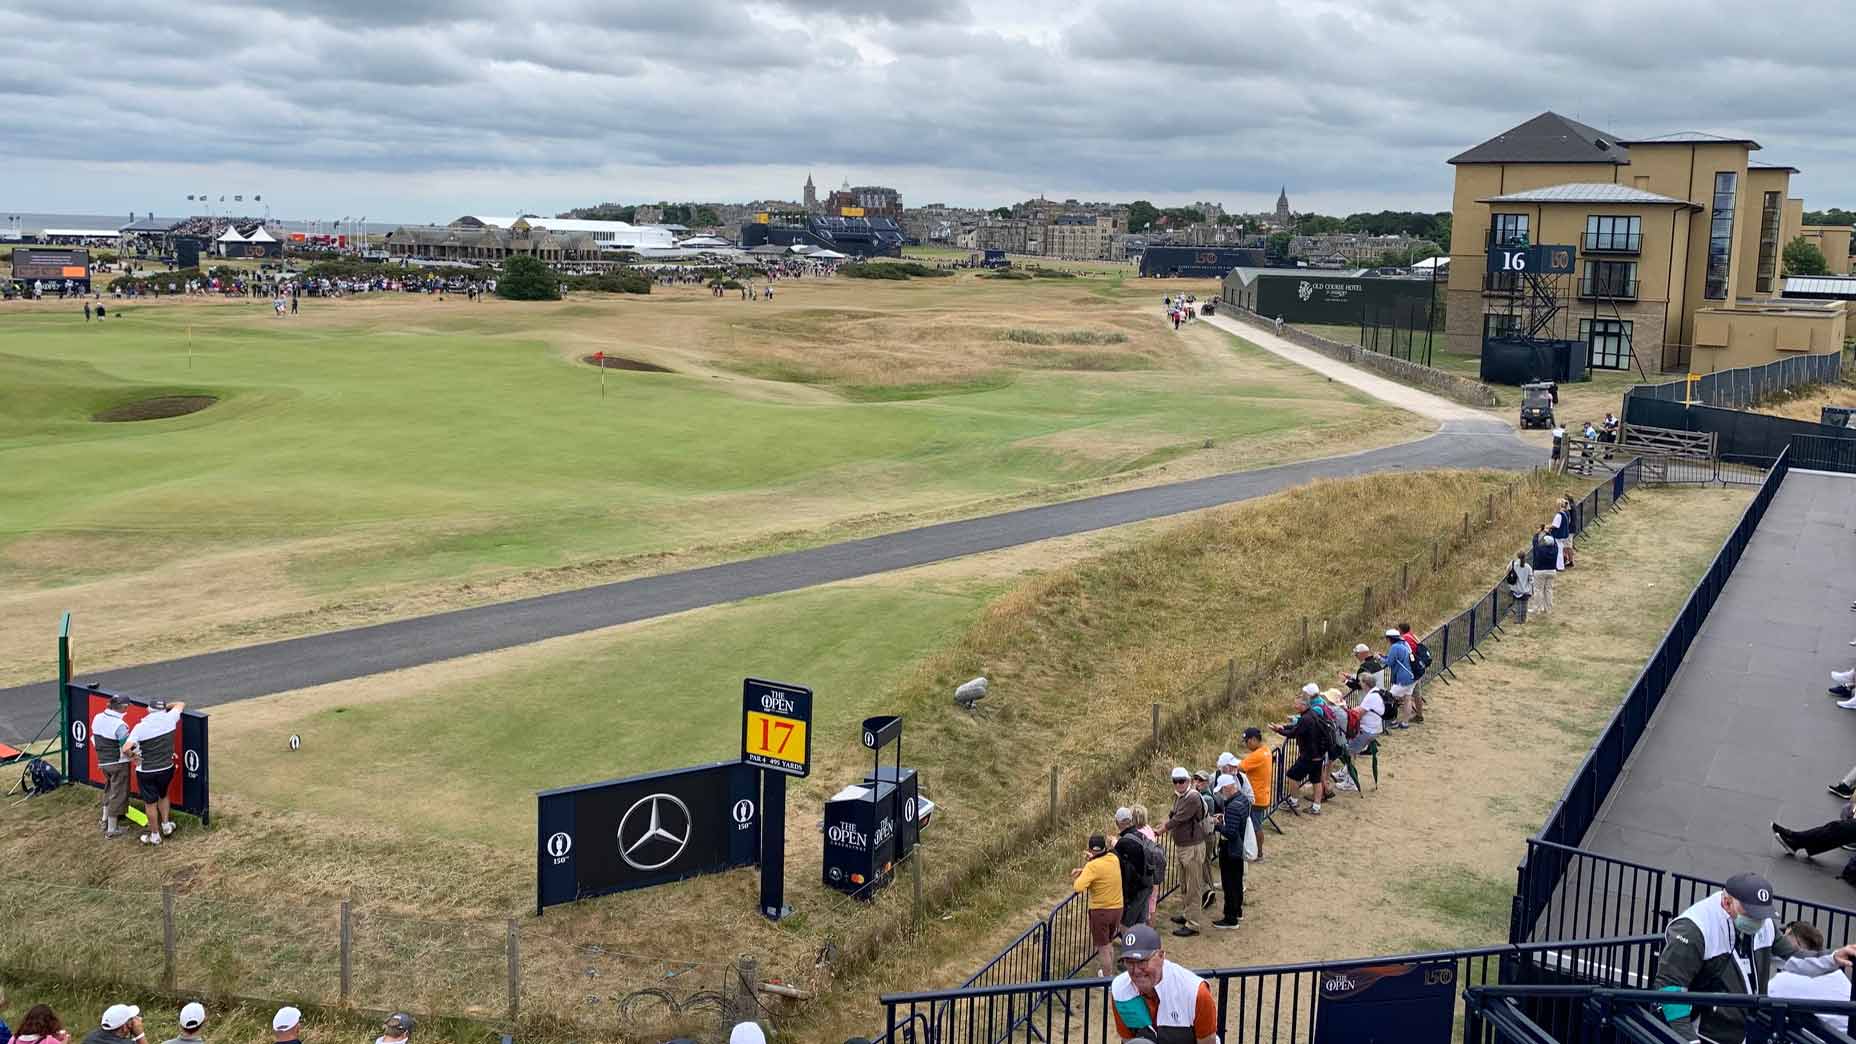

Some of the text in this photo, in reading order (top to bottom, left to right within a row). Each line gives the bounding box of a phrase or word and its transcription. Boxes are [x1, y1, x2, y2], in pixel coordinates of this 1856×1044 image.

[1503, 252, 1525, 270] 16
[771, 690, 785, 699] THE
[761, 695, 794, 712] OPEN
[760, 718, 795, 754] 17
[750, 754, 761, 762] PAR
[782, 761, 803, 770] YARDS
[840, 821, 857, 832] THE
[829, 826, 867, 847] OPEN
[1326, 980, 1355, 991] OPEN
